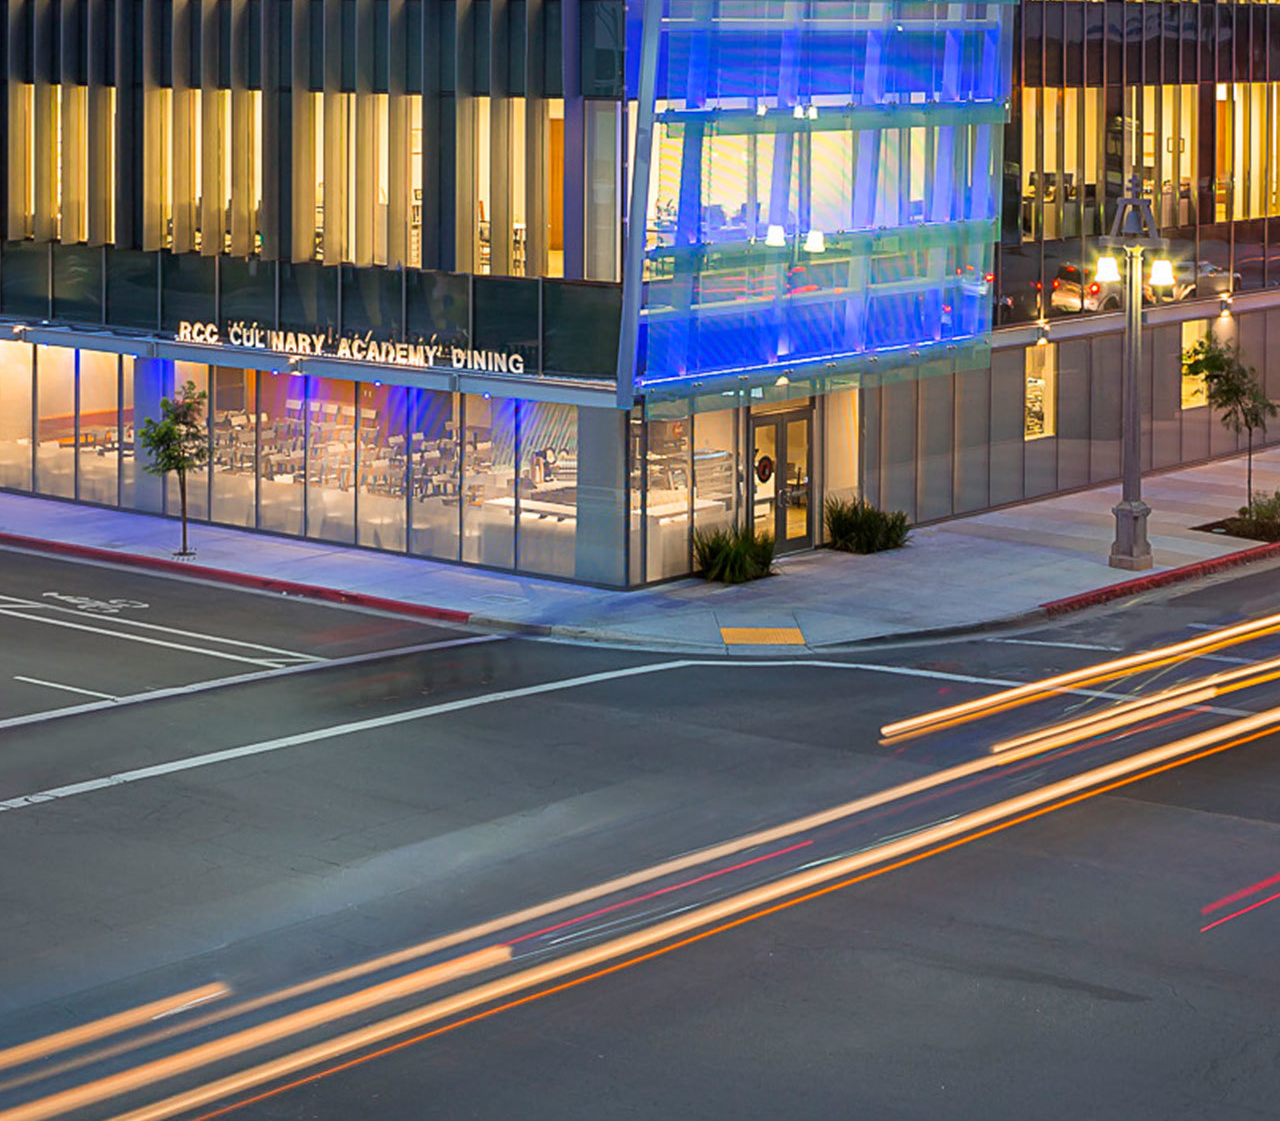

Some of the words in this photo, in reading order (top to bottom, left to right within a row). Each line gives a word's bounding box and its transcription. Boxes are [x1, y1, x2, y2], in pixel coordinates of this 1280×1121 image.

[179, 321, 219, 342] RCC
[229, 327, 326, 356] CULINARY
[337, 337, 437, 367] ACADEMY
[452, 346, 524, 374] DINING
